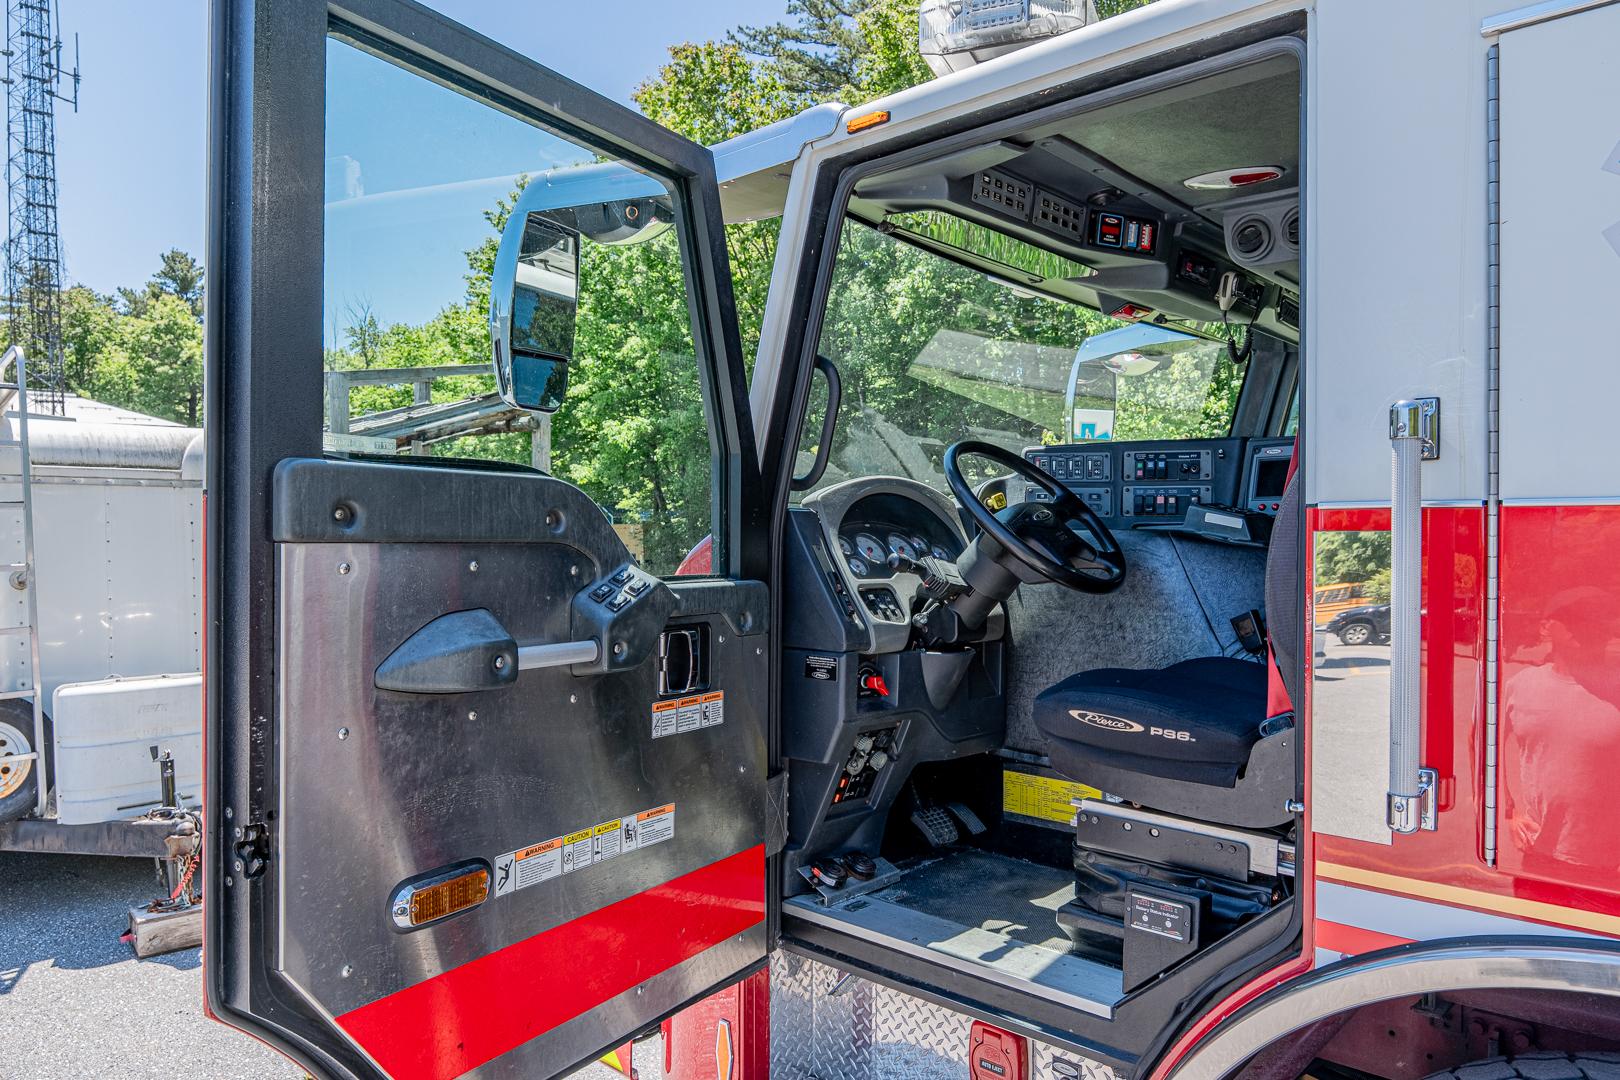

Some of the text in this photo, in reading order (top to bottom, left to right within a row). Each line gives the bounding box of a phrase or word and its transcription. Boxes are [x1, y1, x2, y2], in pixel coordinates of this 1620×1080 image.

[1086, 714, 1125, 728] Pierce
[601, 823, 618, 832] CAUTION
[567, 831, 590, 843] CAUTION
[530, 842, 555, 855] WARNING
